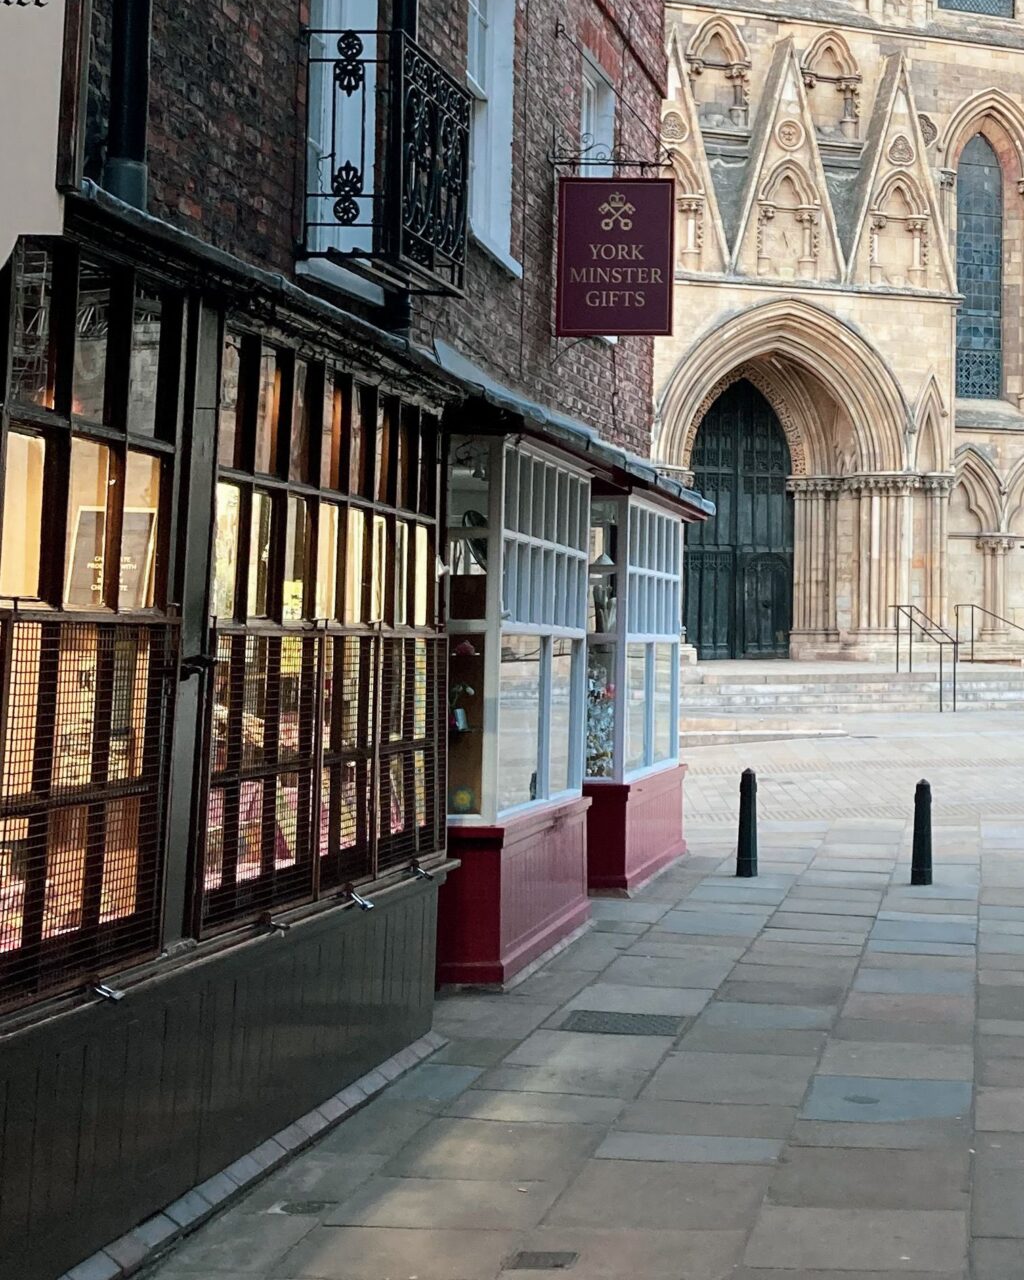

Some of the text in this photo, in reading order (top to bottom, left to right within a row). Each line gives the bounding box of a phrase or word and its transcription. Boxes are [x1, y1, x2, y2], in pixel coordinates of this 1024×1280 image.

[589, 243, 645, 260] YORK
[570, 267, 664, 284] MINSTER
[585, 290, 646, 307] GIFTS
